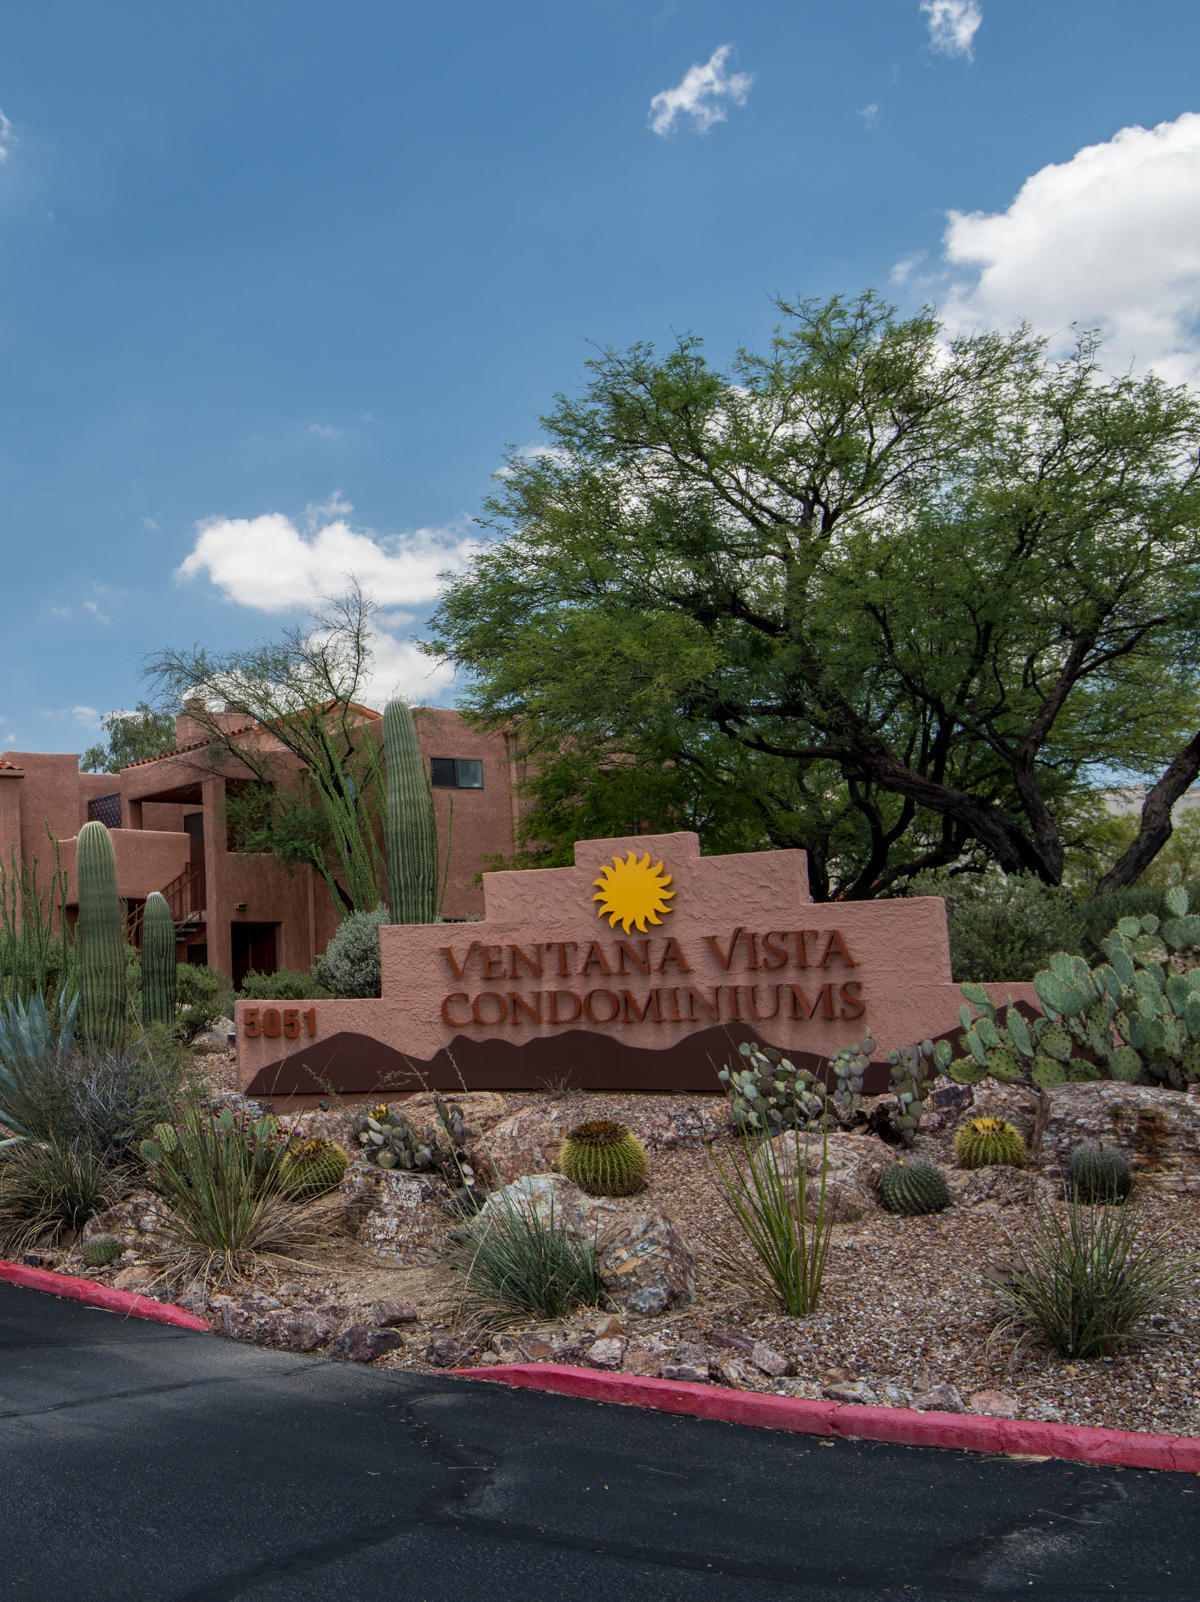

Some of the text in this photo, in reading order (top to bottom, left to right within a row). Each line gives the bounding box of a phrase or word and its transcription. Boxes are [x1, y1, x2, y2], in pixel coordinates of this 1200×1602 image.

[439, 926, 861, 980] VENTANA VISTA
[243, 1007, 317, 1039] 5051
[441, 981, 866, 1026] CONDOMINIUMS
